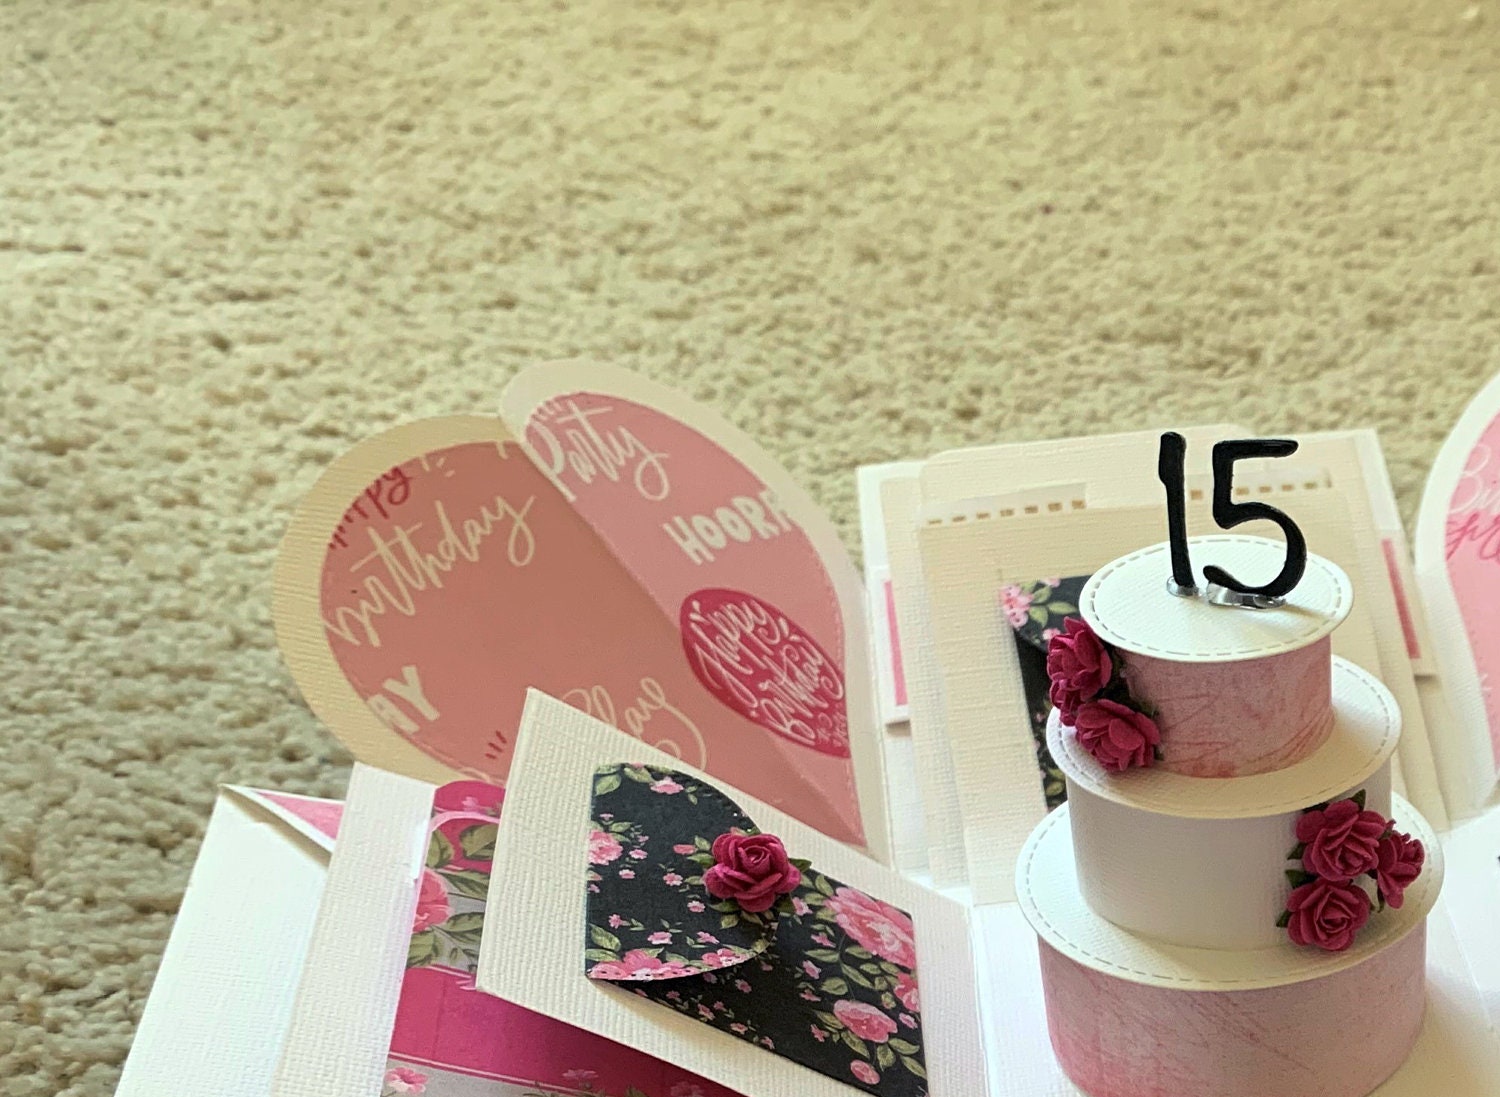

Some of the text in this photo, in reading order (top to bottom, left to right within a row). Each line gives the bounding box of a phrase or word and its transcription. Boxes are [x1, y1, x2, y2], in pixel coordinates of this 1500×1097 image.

[521, 400, 671, 502] Party
[1158, 431, 1307, 597] 15
[691, 599, 780, 708] Happy
